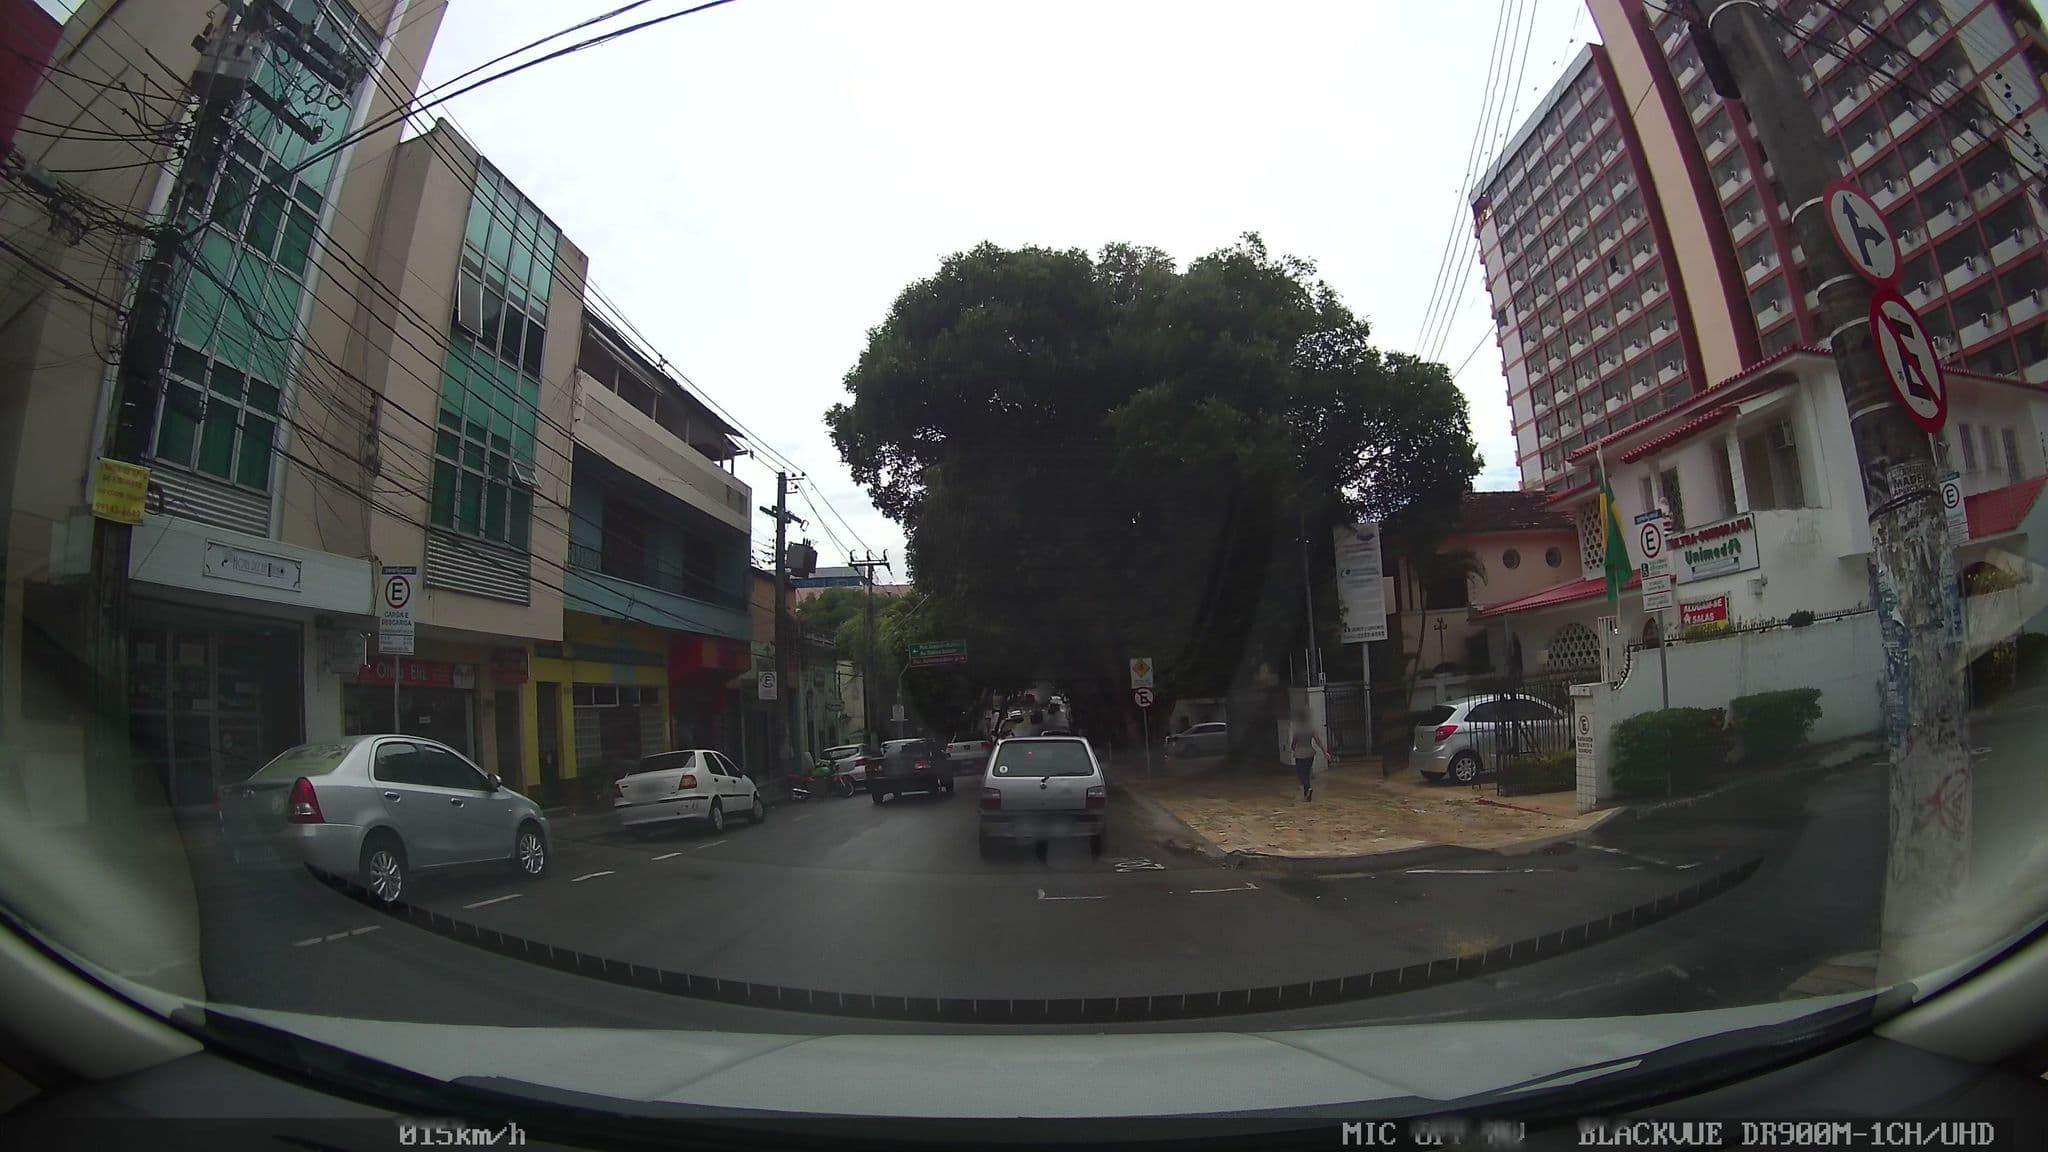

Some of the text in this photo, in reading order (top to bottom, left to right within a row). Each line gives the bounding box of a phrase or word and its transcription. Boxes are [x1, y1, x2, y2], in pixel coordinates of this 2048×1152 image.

[1946, 488, 1956, 504] E
[1645, 530, 1657, 551] E
[1684, 542, 1728, 565] Unimed
[391, 582, 404, 601] E
